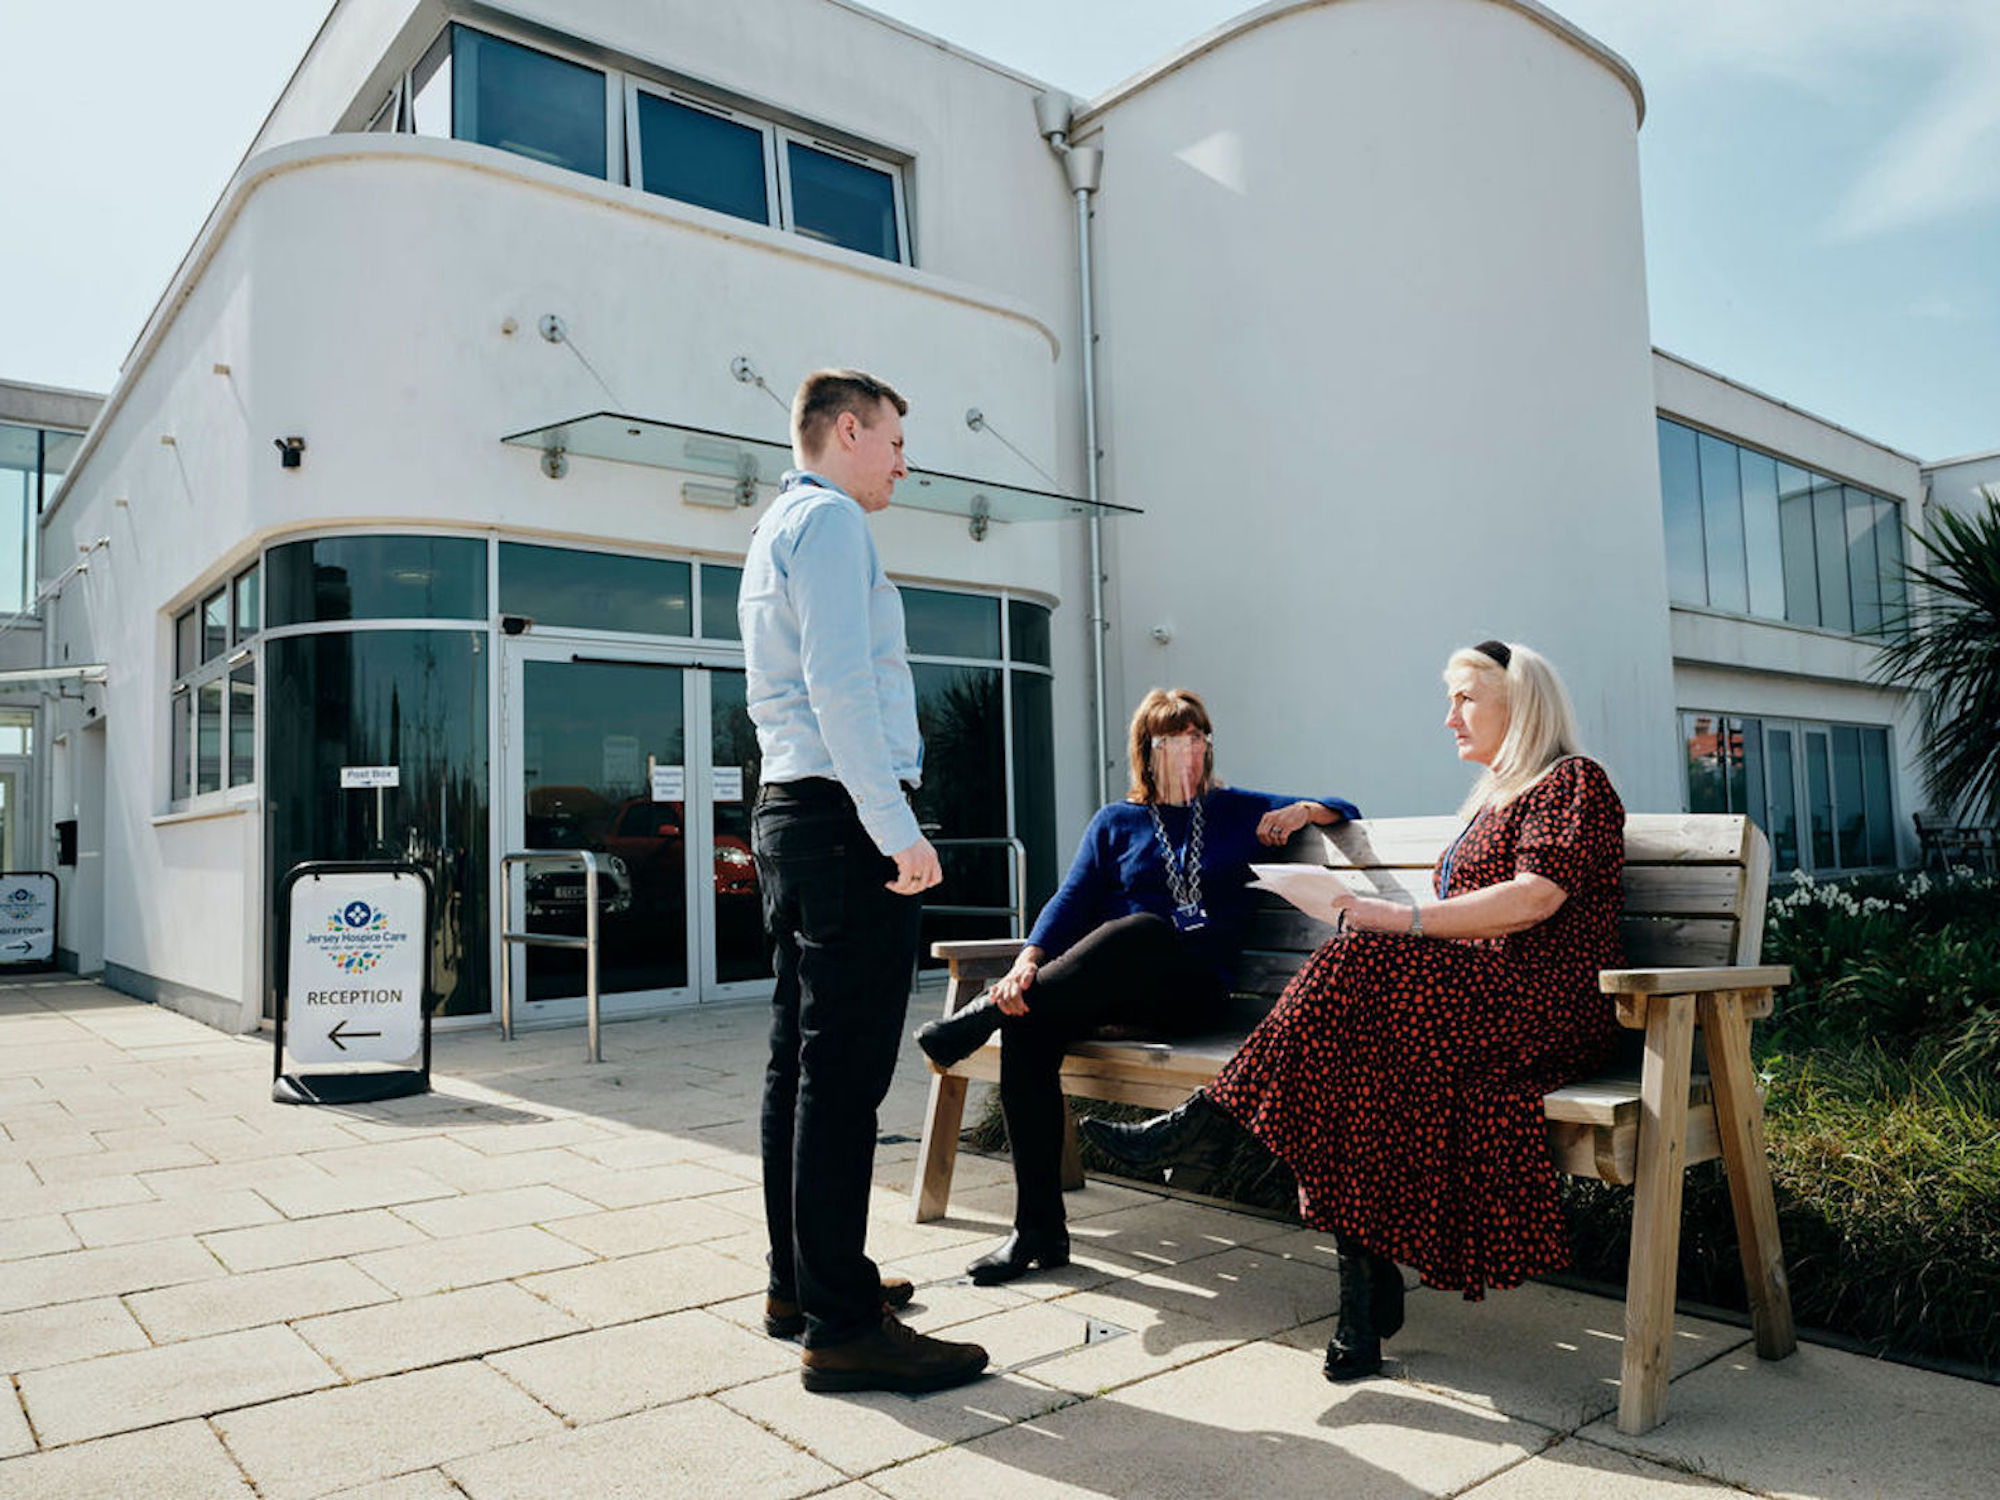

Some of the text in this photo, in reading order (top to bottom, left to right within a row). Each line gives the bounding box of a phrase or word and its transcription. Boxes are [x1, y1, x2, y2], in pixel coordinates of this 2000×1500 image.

[347, 769, 391, 779] Post Box
[306, 931, 407, 944] Jersey Hospice Care
[307, 989, 403, 1005] RECEPTION
